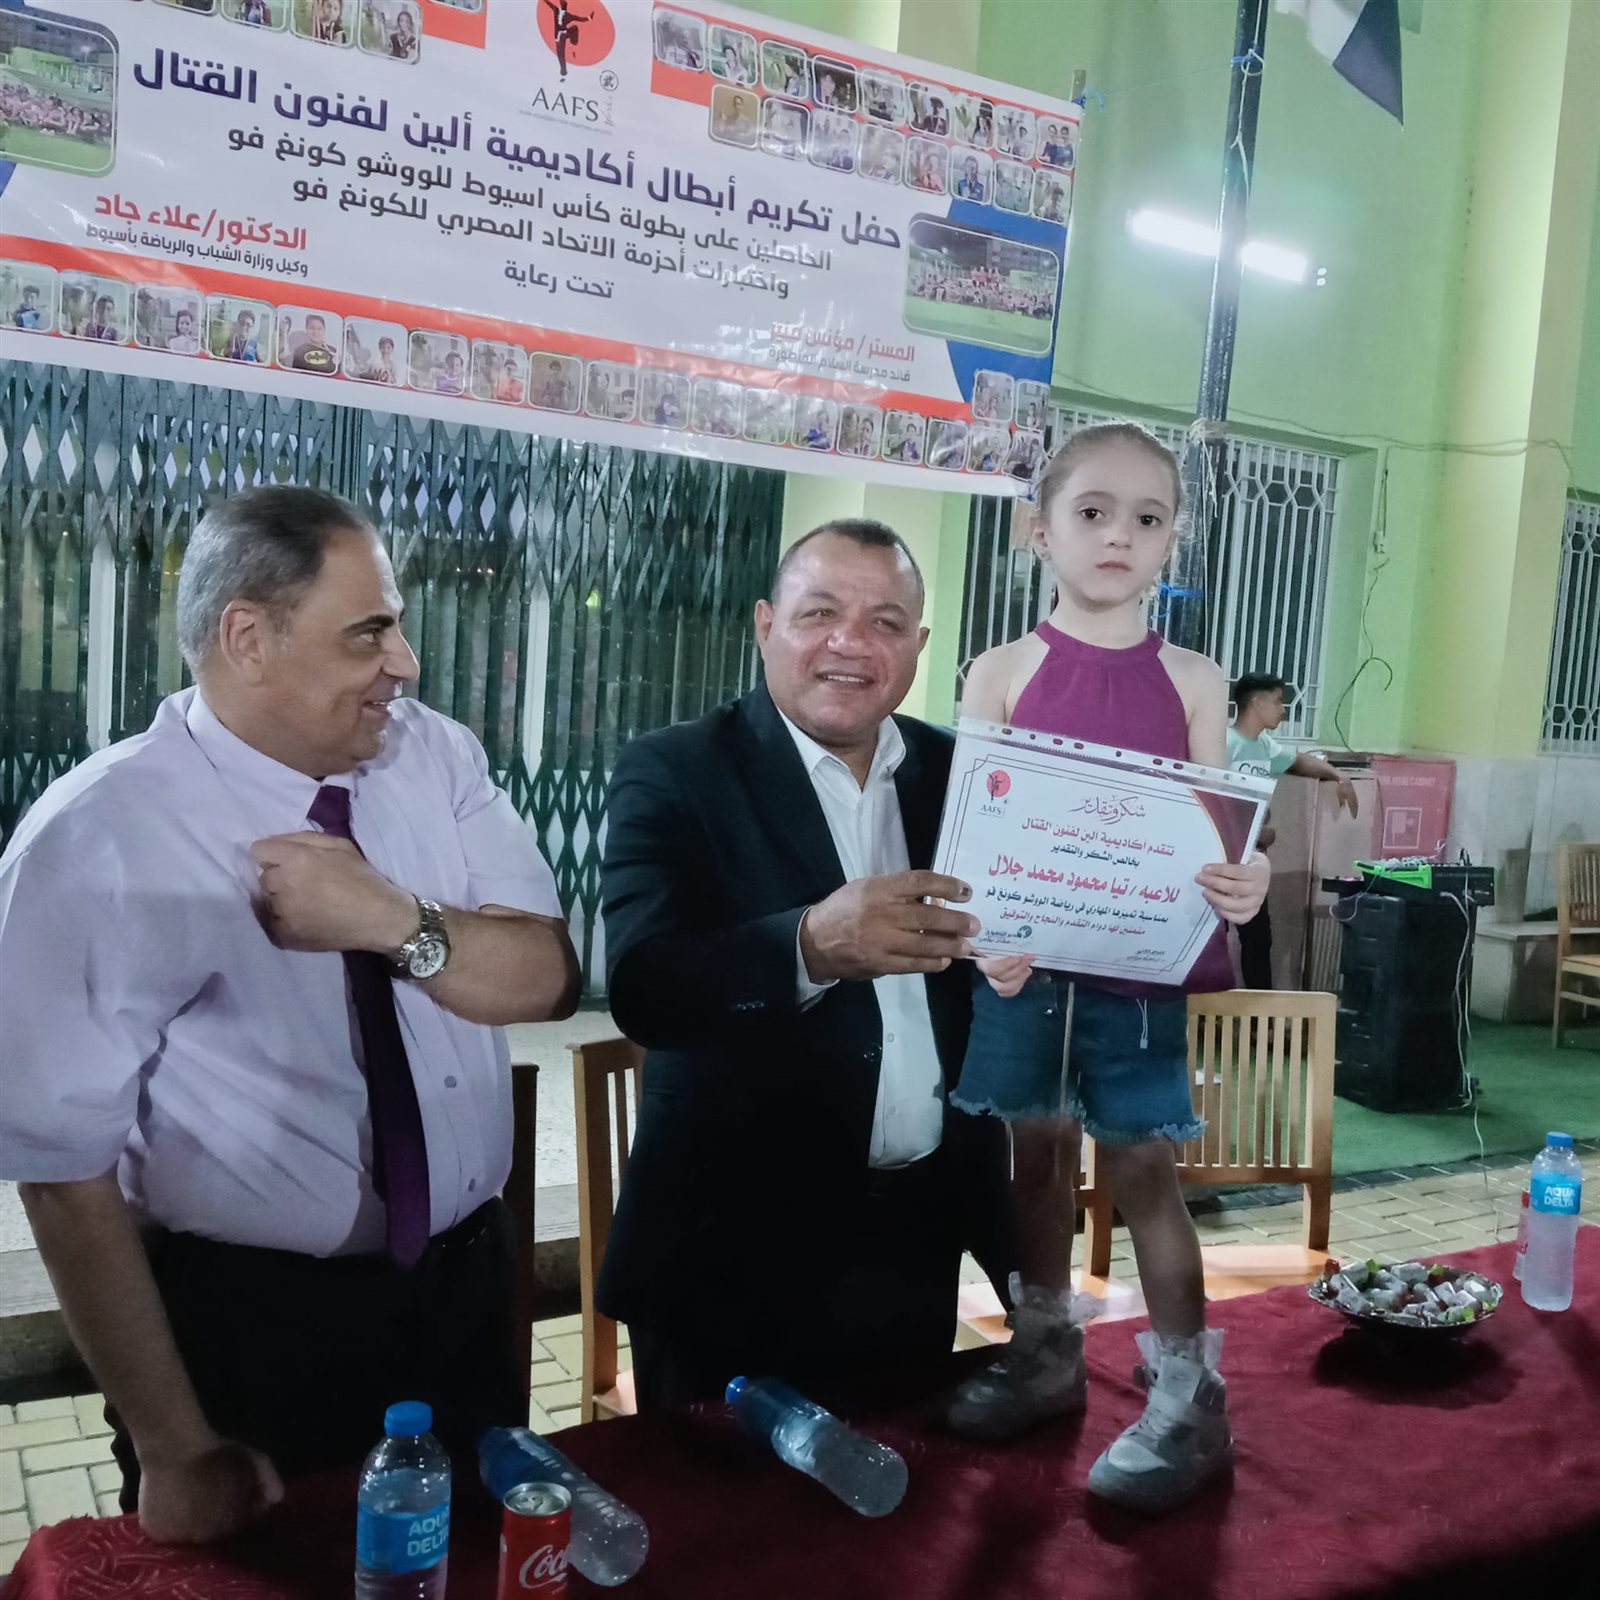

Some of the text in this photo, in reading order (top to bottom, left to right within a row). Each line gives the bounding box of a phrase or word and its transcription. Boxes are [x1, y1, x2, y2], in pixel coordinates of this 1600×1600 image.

[133, 48, 257, 103] القتال
[274, 83, 387, 132] لفنون
[532, 87, 599, 122] AAFS
[403, 111, 472, 155] ألين
[486, 126, 635, 188] أكاديمية
[228, 126, 831, 270] الحاصلين على بطولة كأس اسيوط للووشو كونغ فو
[648, 167, 736, 216] أبطال
[95, 194, 140, 225] جاد
[747, 199, 833, 232] تكريم
[293, 177, 789, 299] واختبارات أحزمة الاتحاد المصري للكونغ فو
[841, 211, 900, 248] حفل
[86, 224, 308, 277] وكيل وزارة الشباب والرياضة بأسيوط
[504, 260, 615, 298] تحت رعاية
[868, 338, 915, 361] المستر
[980, 804, 1002, 816] AAFS
[1022, 818, 1051, 831] القتال
[1053, 825, 1080, 836] لفنون
[1051, 843, 1083, 857] والتقدير
[1084, 850, 1112, 861] الشكر
[989, 854, 1024, 881] جلال
[1027, 864, 1064, 883] محمد
[1067, 872, 1107, 891] محمود
[1544, 1195, 1574, 1207] DELTA
[1545, 1186, 1575, 1197] AQUA
